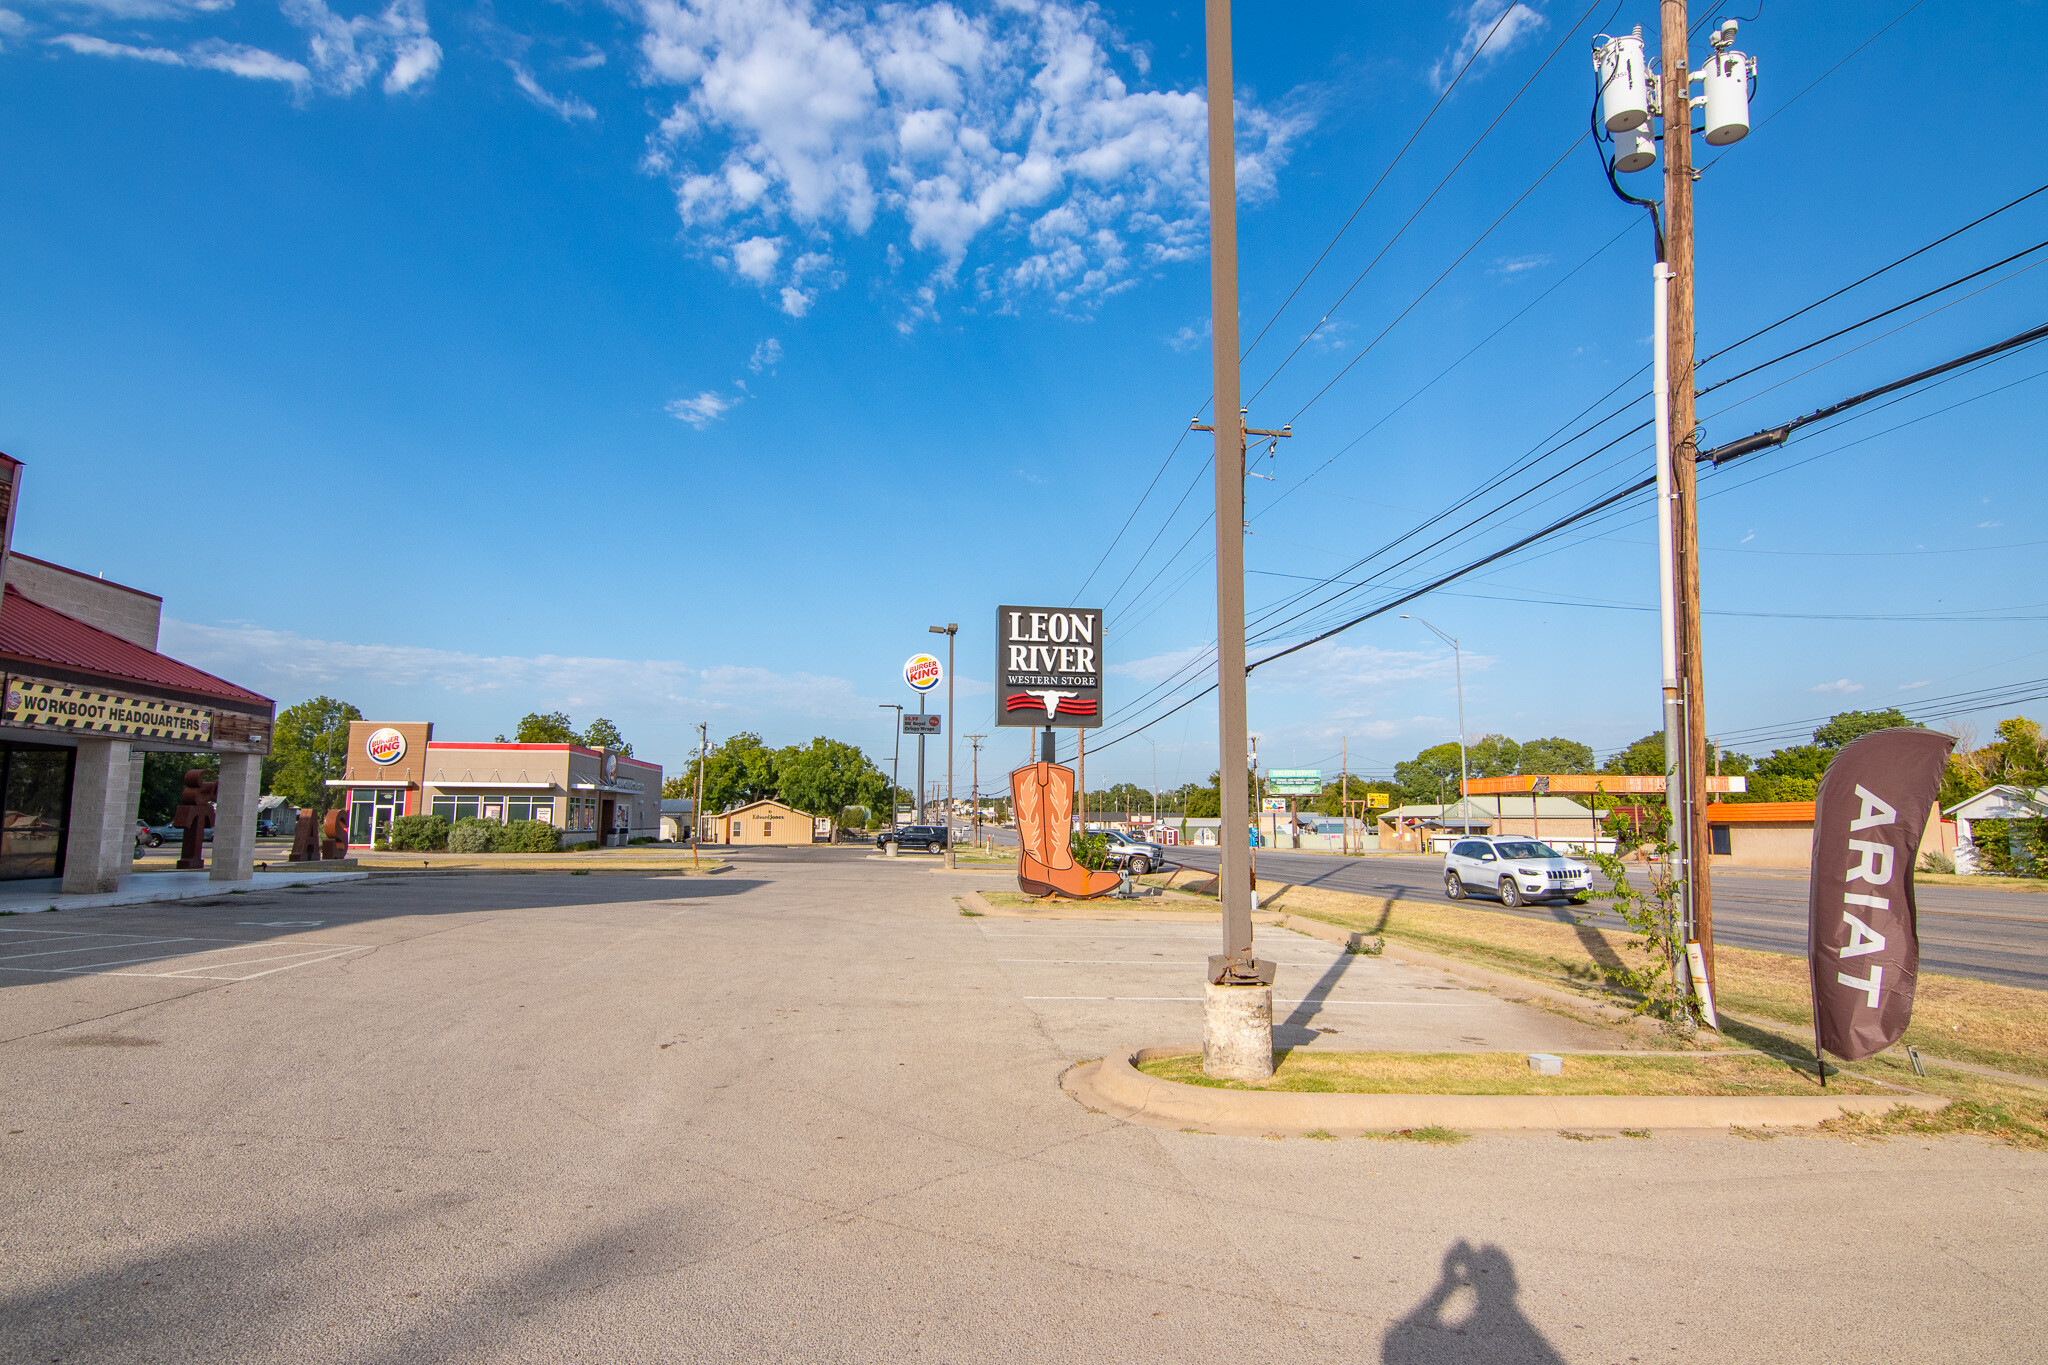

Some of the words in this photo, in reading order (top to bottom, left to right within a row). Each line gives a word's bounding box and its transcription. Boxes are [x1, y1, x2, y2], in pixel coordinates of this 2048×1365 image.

[1008, 612, 1095, 644] LEON
[909, 660, 937, 674] BURGER
[1008, 645, 1096, 673] RIVER
[910, 667, 939, 683] KING
[1008, 675, 1058, 685] WESTERN
[1061, 676, 1096, 686] STORE
[23, 695, 106, 719] WORKBOOT
[108, 708, 200, 731] HEADQUARTERS
[372, 741, 400, 756] KING
[1837, 783, 1897, 1009] ARIAT
